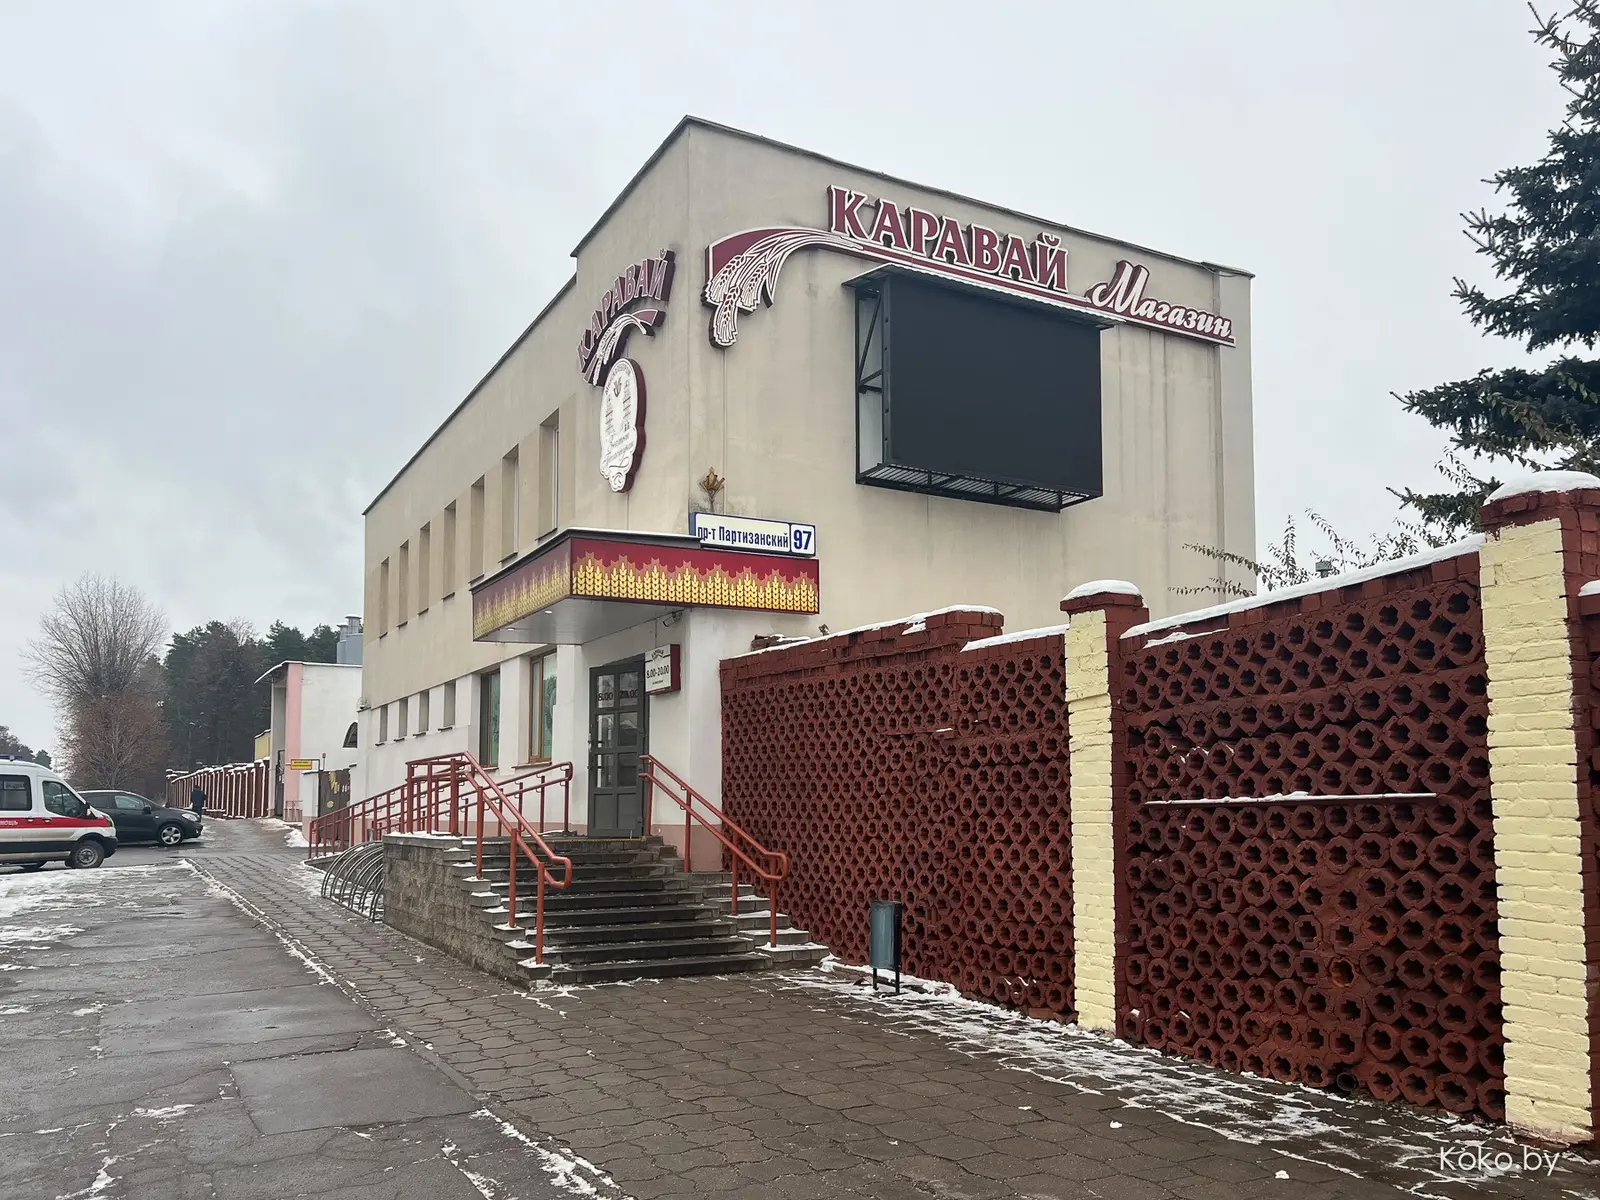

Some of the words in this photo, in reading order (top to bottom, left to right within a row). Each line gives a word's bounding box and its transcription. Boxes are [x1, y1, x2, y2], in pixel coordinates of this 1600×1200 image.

[828, 185, 1068, 293] КАРАВАЙ
[577, 248, 669, 370] КАРАВАЙ
[1090, 261, 1233, 340] Магазин
[697, 526, 716, 541] пр-т
[719, 526, 789, 548] Партизанский
[793, 529, 812, 550] 97
